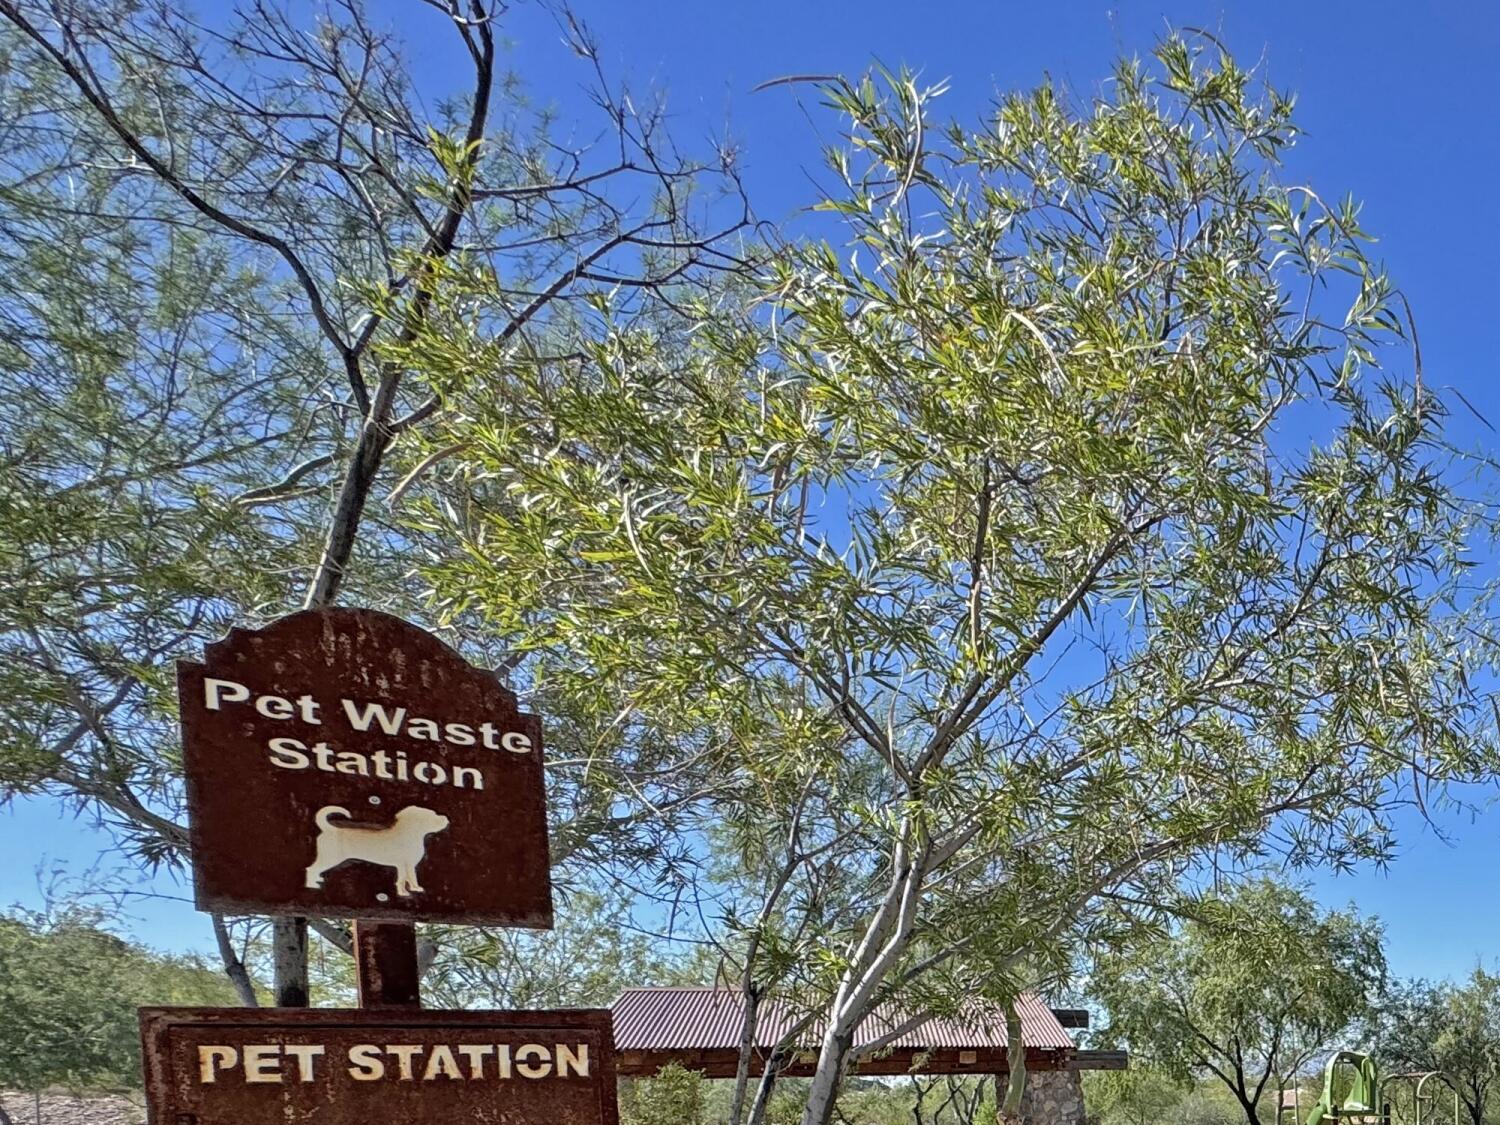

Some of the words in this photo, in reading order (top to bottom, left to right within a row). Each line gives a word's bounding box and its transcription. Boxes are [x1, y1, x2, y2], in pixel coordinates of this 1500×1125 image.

[204, 678, 322, 725] Pet
[342, 699, 533, 754] Waste
[268, 738, 484, 790] Station
[199, 1045, 325, 1083] PET
[348, 1043, 590, 1081] STATION
